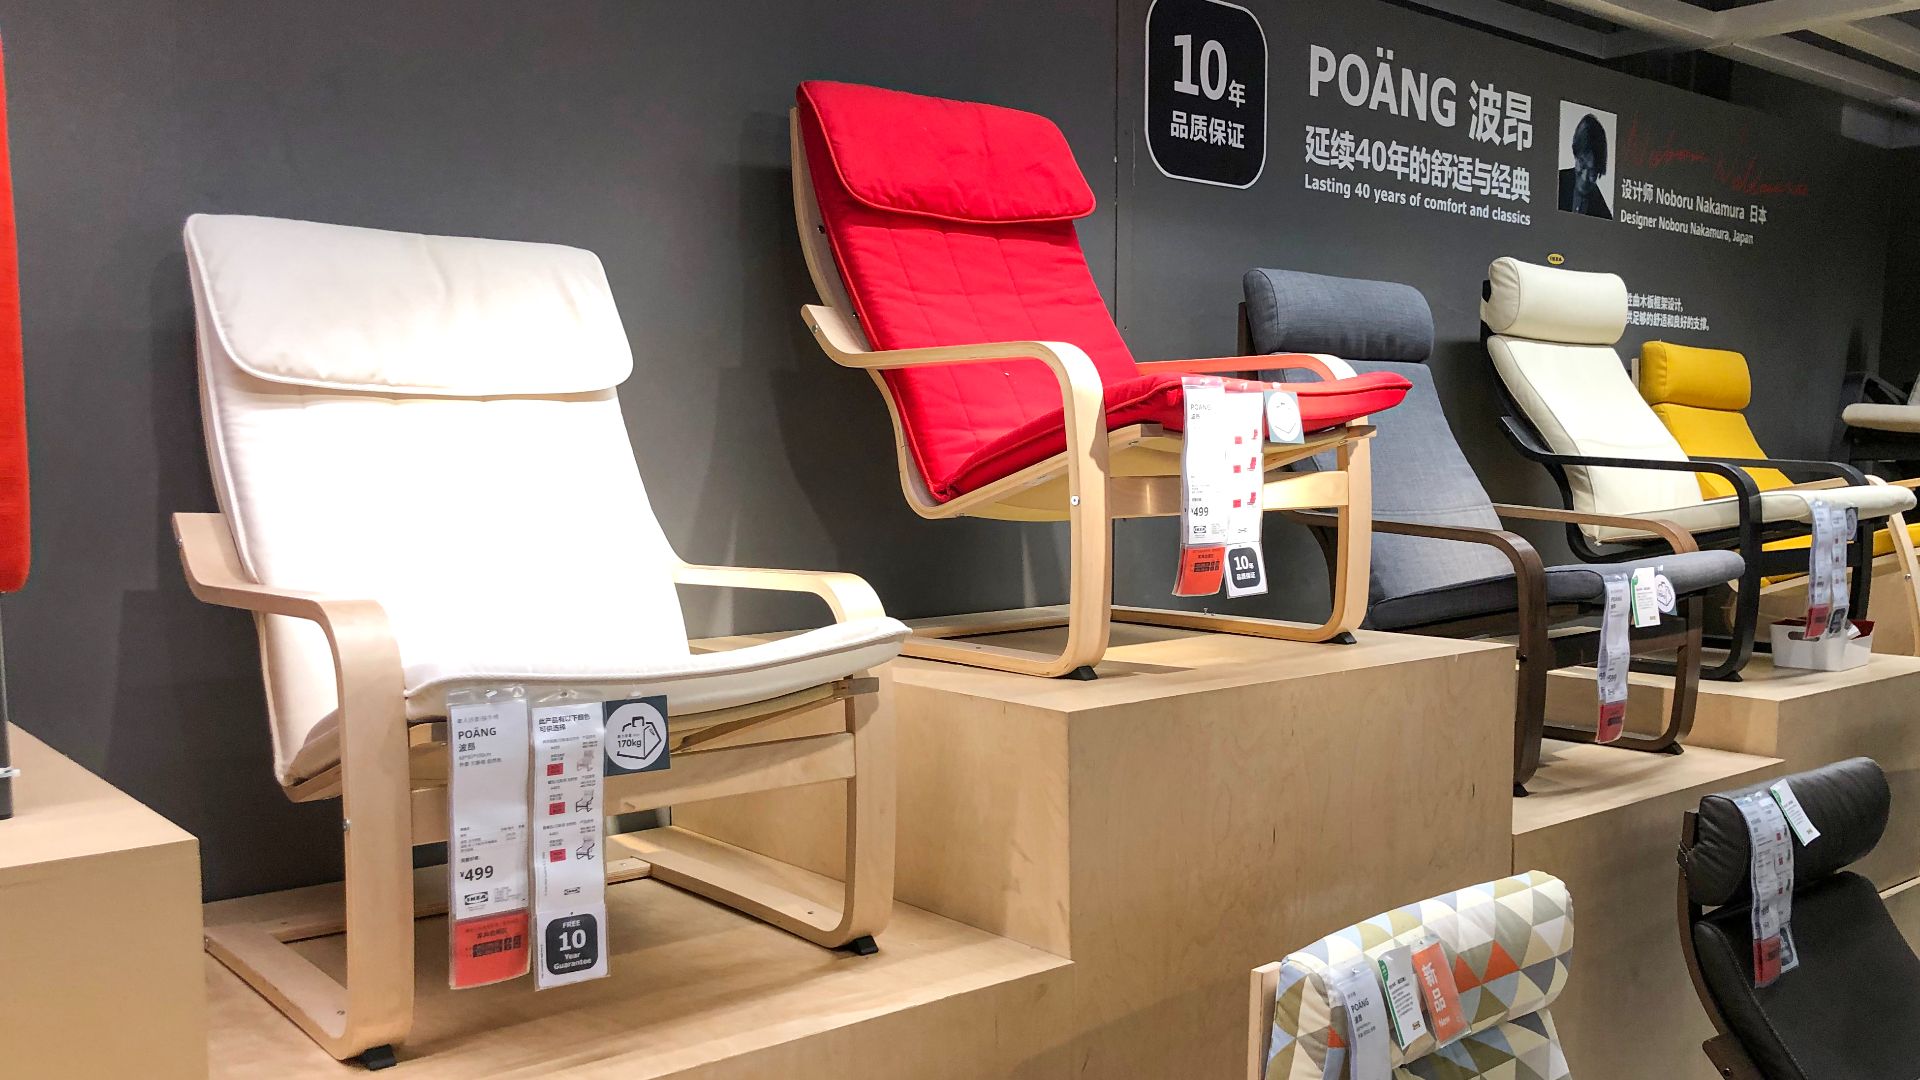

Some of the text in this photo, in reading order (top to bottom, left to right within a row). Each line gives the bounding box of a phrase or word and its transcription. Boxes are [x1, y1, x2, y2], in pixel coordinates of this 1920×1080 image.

[1174, 34, 1246, 108] 10年
[1309, 44, 1457, 128] POÄNG
[1468, 79, 1533, 152] 波昂
[1170, 110, 1245, 149] 品质保证
[1304, 125, 1531, 204] 延续40年的舒适与经典
[1304, 173, 1531, 226] Lasting 40 years of comfort and classics
[1621, 178, 1767, 225] 设计师 Noboru Nakamura 日本
[1620, 209, 1754, 246] Designer Noboru Nakamura, Japan
[1191, 506, 1209, 517] ¥499
[458, 726, 497, 740] POÄNG
[617, 738, 642, 748] 170kg
[460, 865, 494, 881] ¥499
[562, 919, 581, 928] FREE
[559, 929, 587, 952] 10
[553, 958, 592, 970] Guarantee
[564, 952, 581, 960] Year
